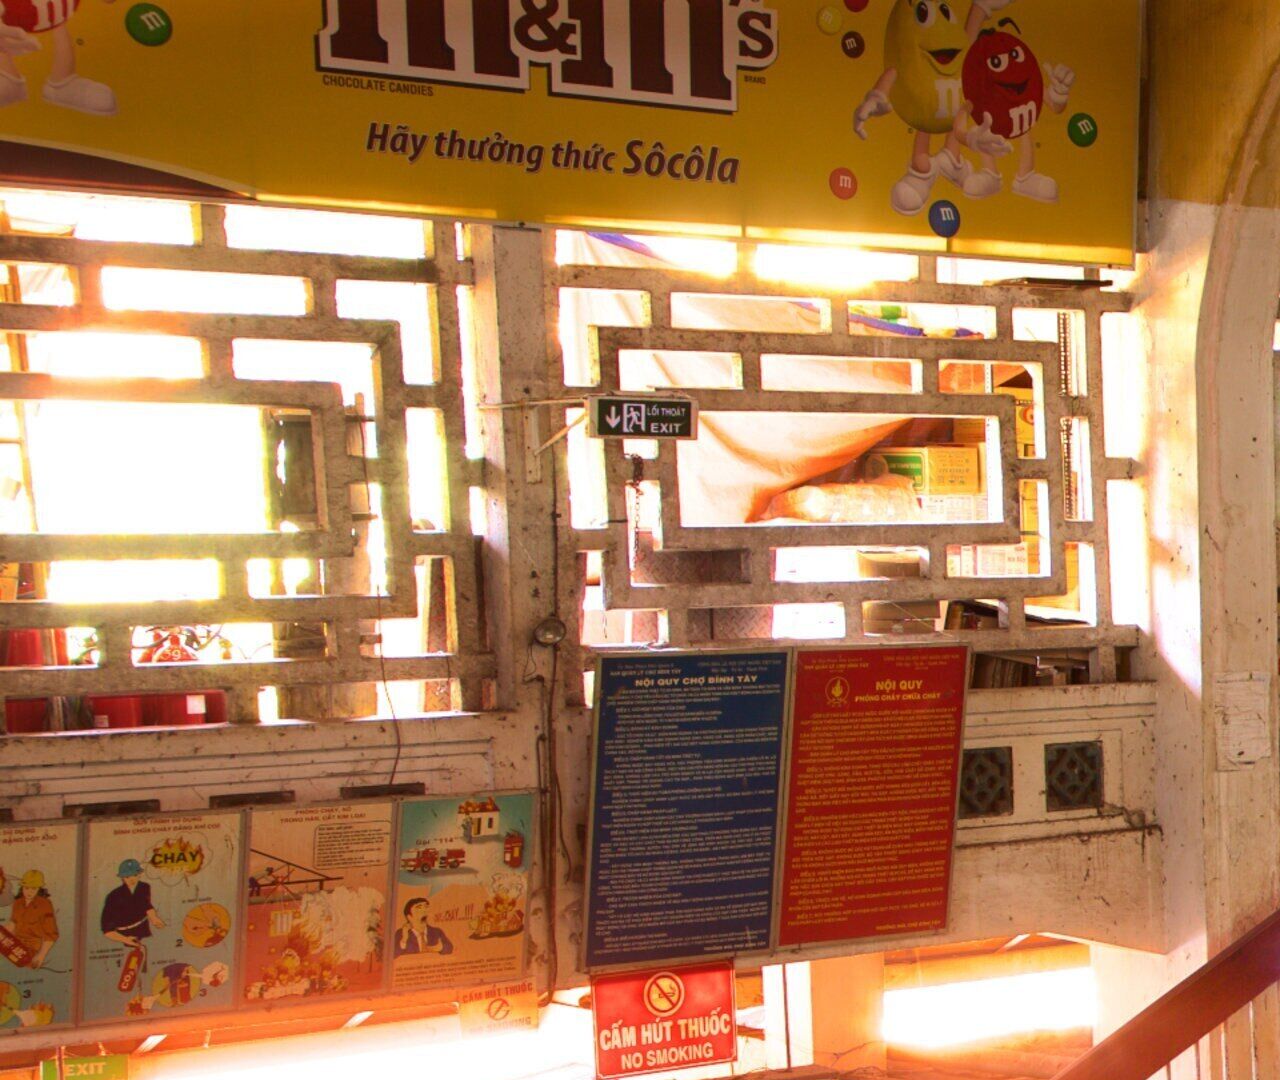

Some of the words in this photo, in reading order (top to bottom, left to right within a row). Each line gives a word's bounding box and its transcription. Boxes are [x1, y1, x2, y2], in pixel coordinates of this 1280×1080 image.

[322, 74, 387, 93] CHOCOLATE
[387, 82, 434, 97] CANDIES
[366, 121, 427, 163] Hãy
[434, 131, 544, 174] thưởng
[551, 140, 615, 173] thức
[622, 140, 740, 185] Sôcôla
[650, 422, 682, 433] EXIT
[635, 678, 654, 688] NỘI
[657, 677, 679, 686] QUY
[682, 676, 705, 687] CHỢ
[876, 679, 896, 693] NỘI
[899, 679, 923, 690] QUY
[599, 1019, 637, 1051] CẤM
[641, 1017, 673, 1046] HÚT
[677, 1006, 732, 1041] THUỐC
[620, 1053, 644, 1070] NO
[646, 1042, 714, 1067] SMOKING
[64, 1062, 107, 1077] EXIT
